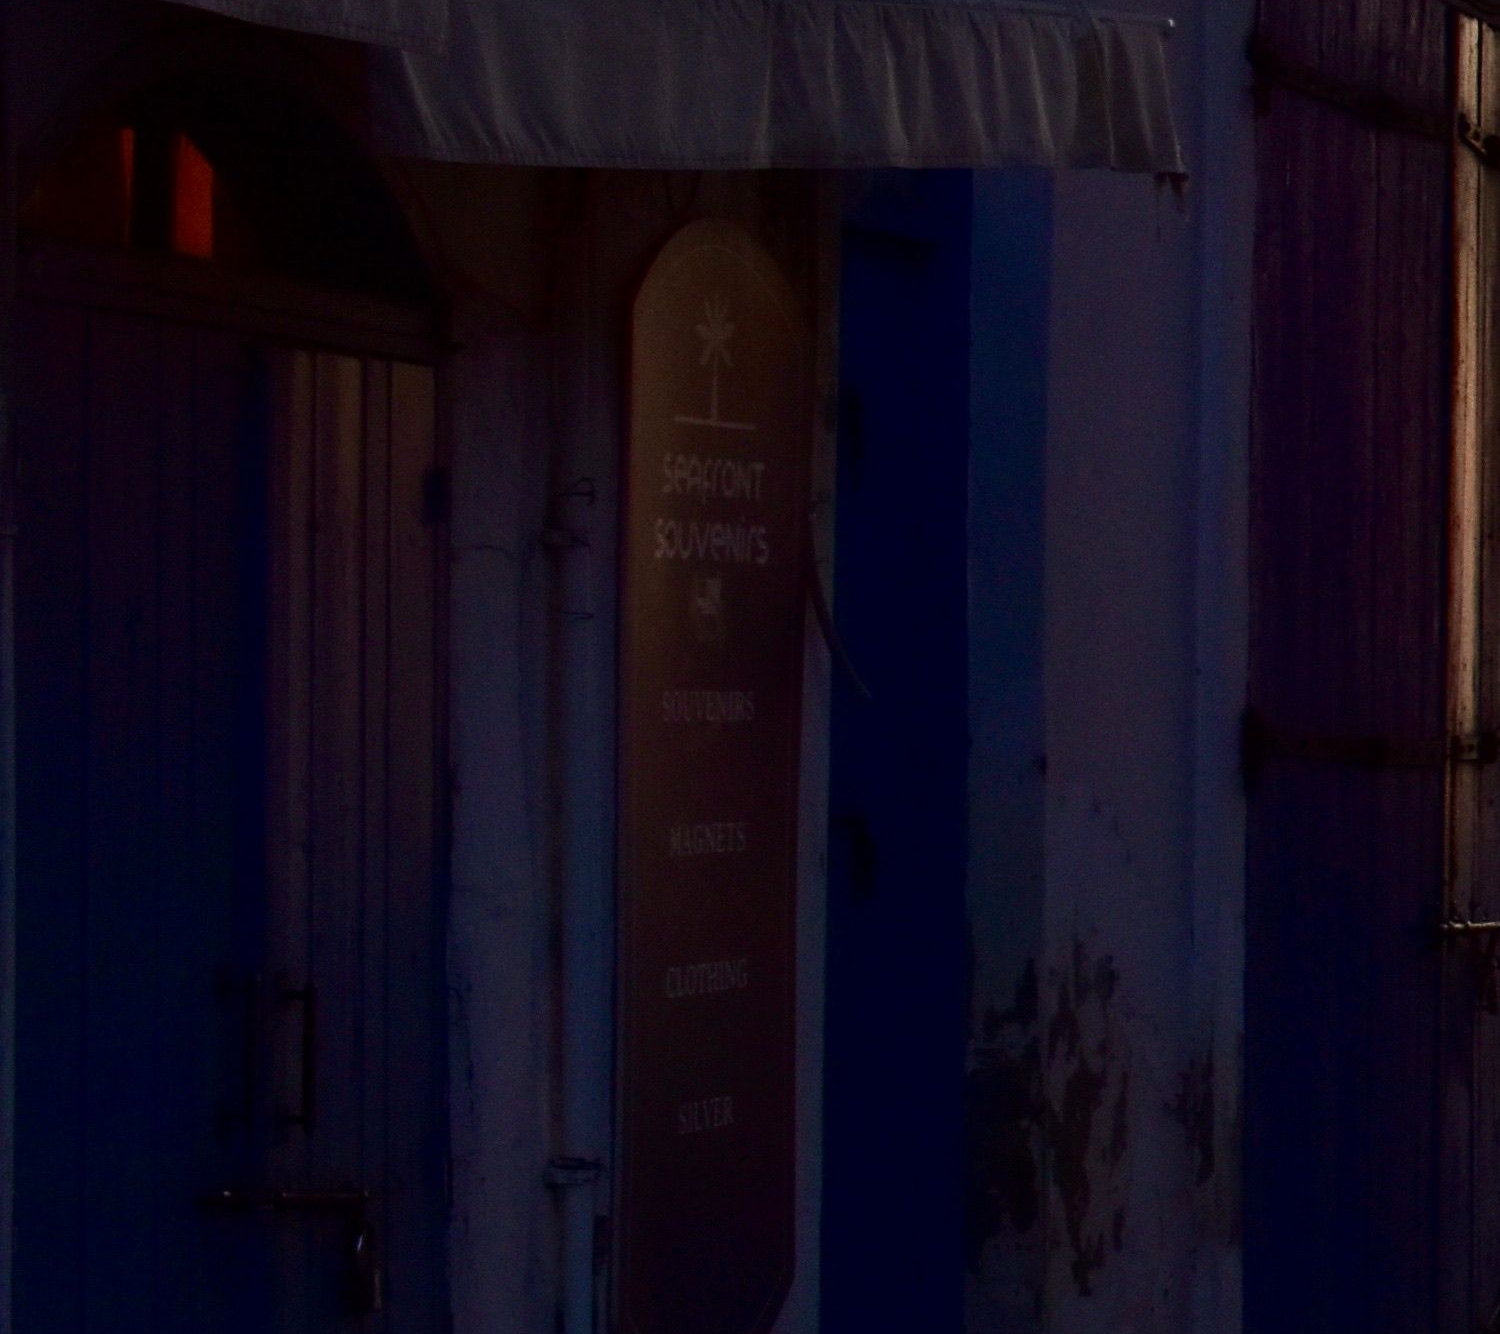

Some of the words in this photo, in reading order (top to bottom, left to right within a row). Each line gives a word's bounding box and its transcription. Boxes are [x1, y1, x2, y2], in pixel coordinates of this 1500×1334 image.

[661, 690, 756, 723] SOUVENIRS
[668, 821, 748, 858] MAGNETS
[664, 958, 750, 999] CLOTHING
[677, 1095, 735, 1135] SILVER
